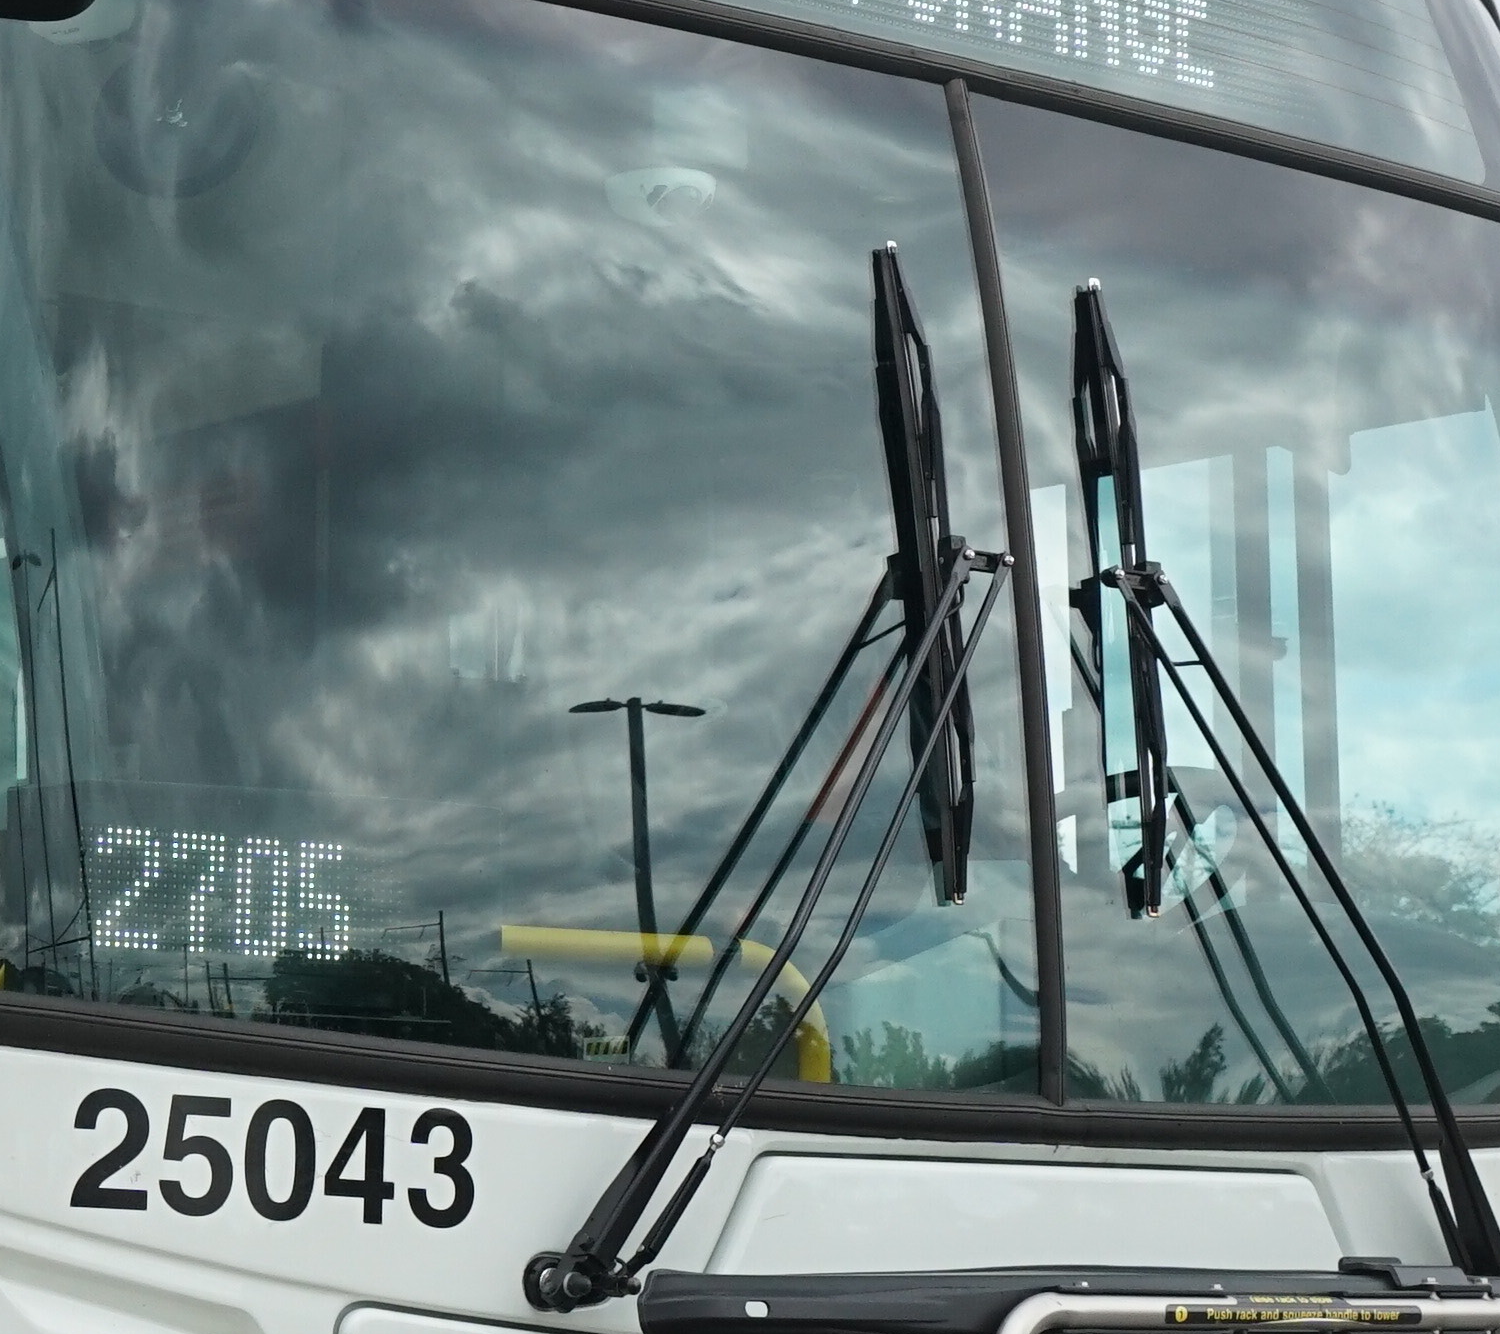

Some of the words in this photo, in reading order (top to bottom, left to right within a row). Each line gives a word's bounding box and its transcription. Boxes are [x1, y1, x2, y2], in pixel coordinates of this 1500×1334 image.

[96, 827, 349, 961] 2705
[70, 1087, 475, 1229] 25043
[1206, 1307, 1233, 1320] Push
[1236, 1309, 1258, 1320] rack
[1261, 1308, 1279, 1320] and
[1325, 1309, 1359, 1320] handle
[1361, 1309, 1372, 1321] to
[1374, 1309, 1400, 1320] lower
